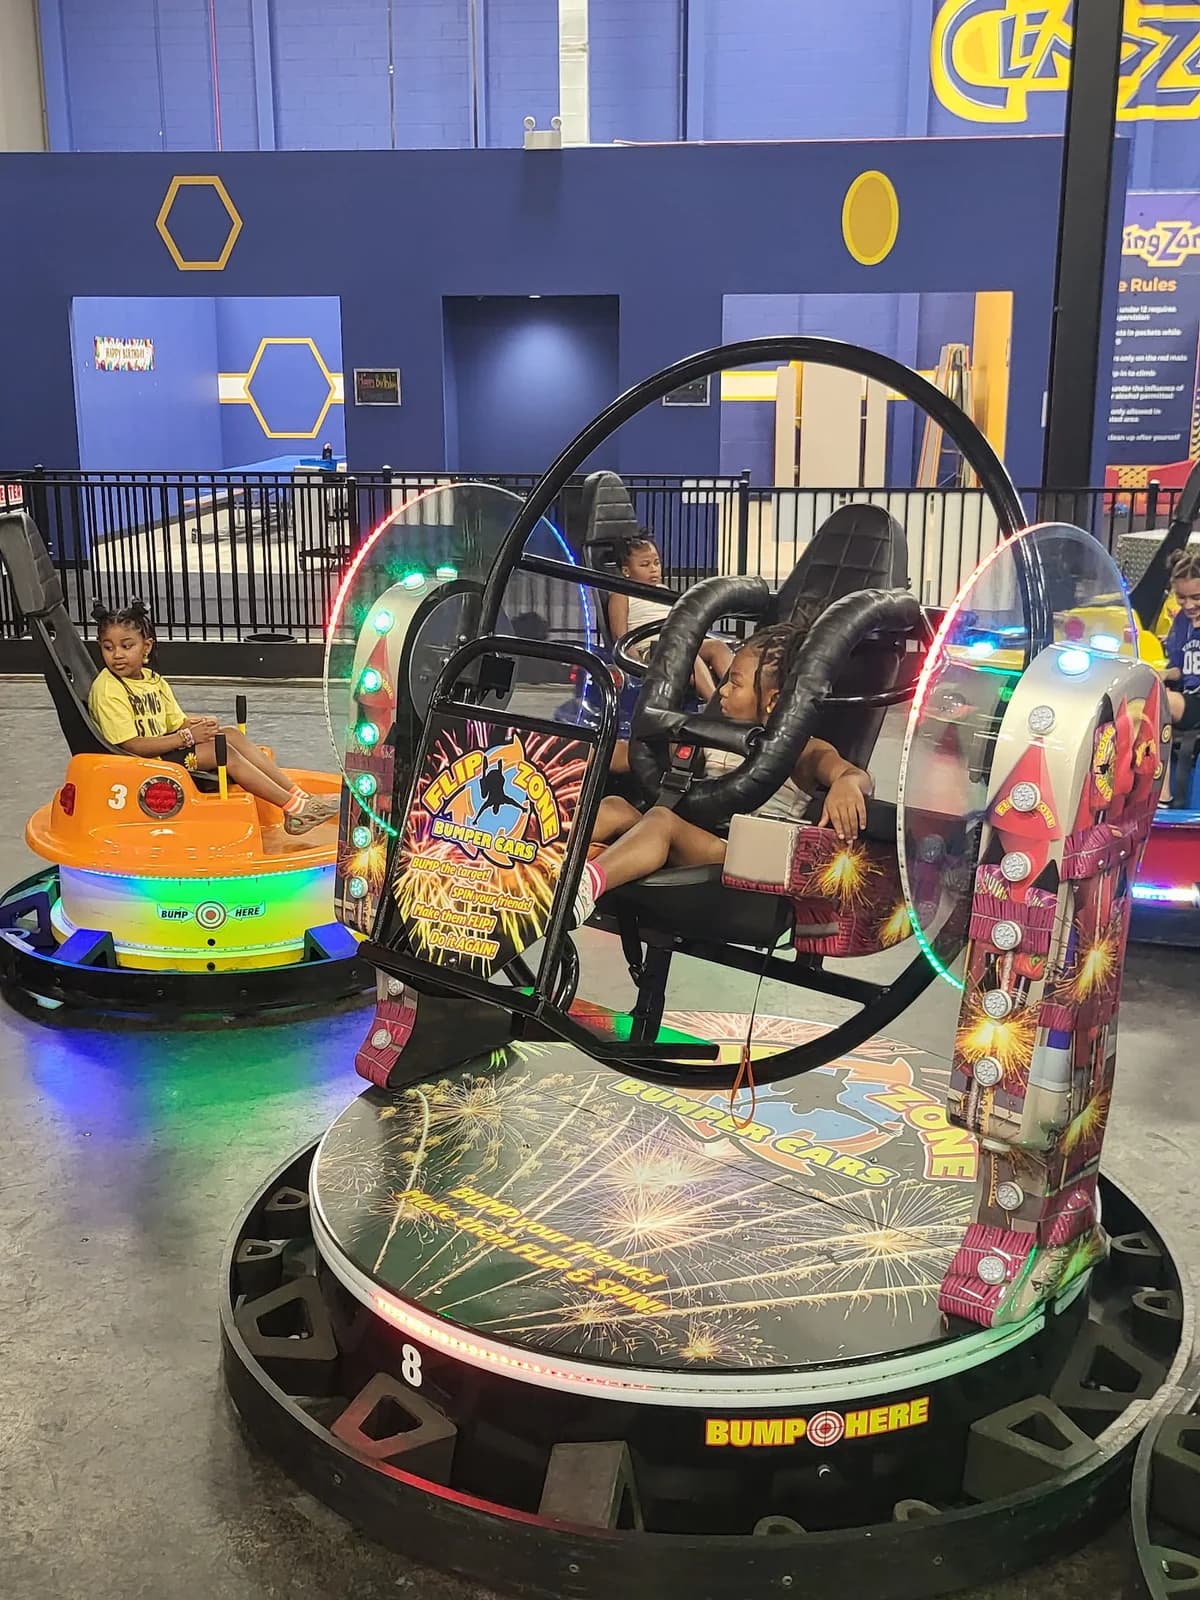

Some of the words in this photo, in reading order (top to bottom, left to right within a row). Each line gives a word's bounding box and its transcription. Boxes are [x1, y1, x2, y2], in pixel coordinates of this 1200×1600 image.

[1131, 277, 1177, 292] Rules
[108, 784, 128, 809] 3
[423, 751, 485, 812] FLIP
[513, 762, 559, 843] ZONE
[433, 819, 492, 848] BUMPER
[494, 834, 537, 860] CARS
[412, 856, 440, 873] BUMP
[440, 863, 456, 877] the
[456, 865, 491, 881] target!
[160, 910, 189, 919] BUMP
[235, 907, 260, 917] HERE
[412, 903, 440, 921] Make
[440, 908, 467, 927] them
[467, 914, 496, 933] FLIP!
[451, 886, 475, 901] SPIN
[474, 892, 497, 908] your
[496, 894, 532, 913] friends!
[430, 931, 447, 946] Do
[446, 934, 457, 947] it
[457, 935, 499, 958] AGAIN!
[612, 1078, 772, 1143] BUMPER
[774, 1136, 899, 1186] CARS
[864, 1085, 980, 1181] ZONE
[399, 1186, 458, 1221] Make
[455, 1215, 517, 1249] them
[512, 1241, 574, 1270] FLIP
[563, 1268, 594, 1284] &
[589, 1277, 669, 1315] SPIN!
[448, 1186, 523, 1219] BUMP
[510, 1216, 574, 1245] your
[562, 1240, 669, 1286] friends!
[401, 1343, 422, 1387] 8
[705, 1418, 808, 1447] BUMP
[843, 1396, 930, 1440] HERE
